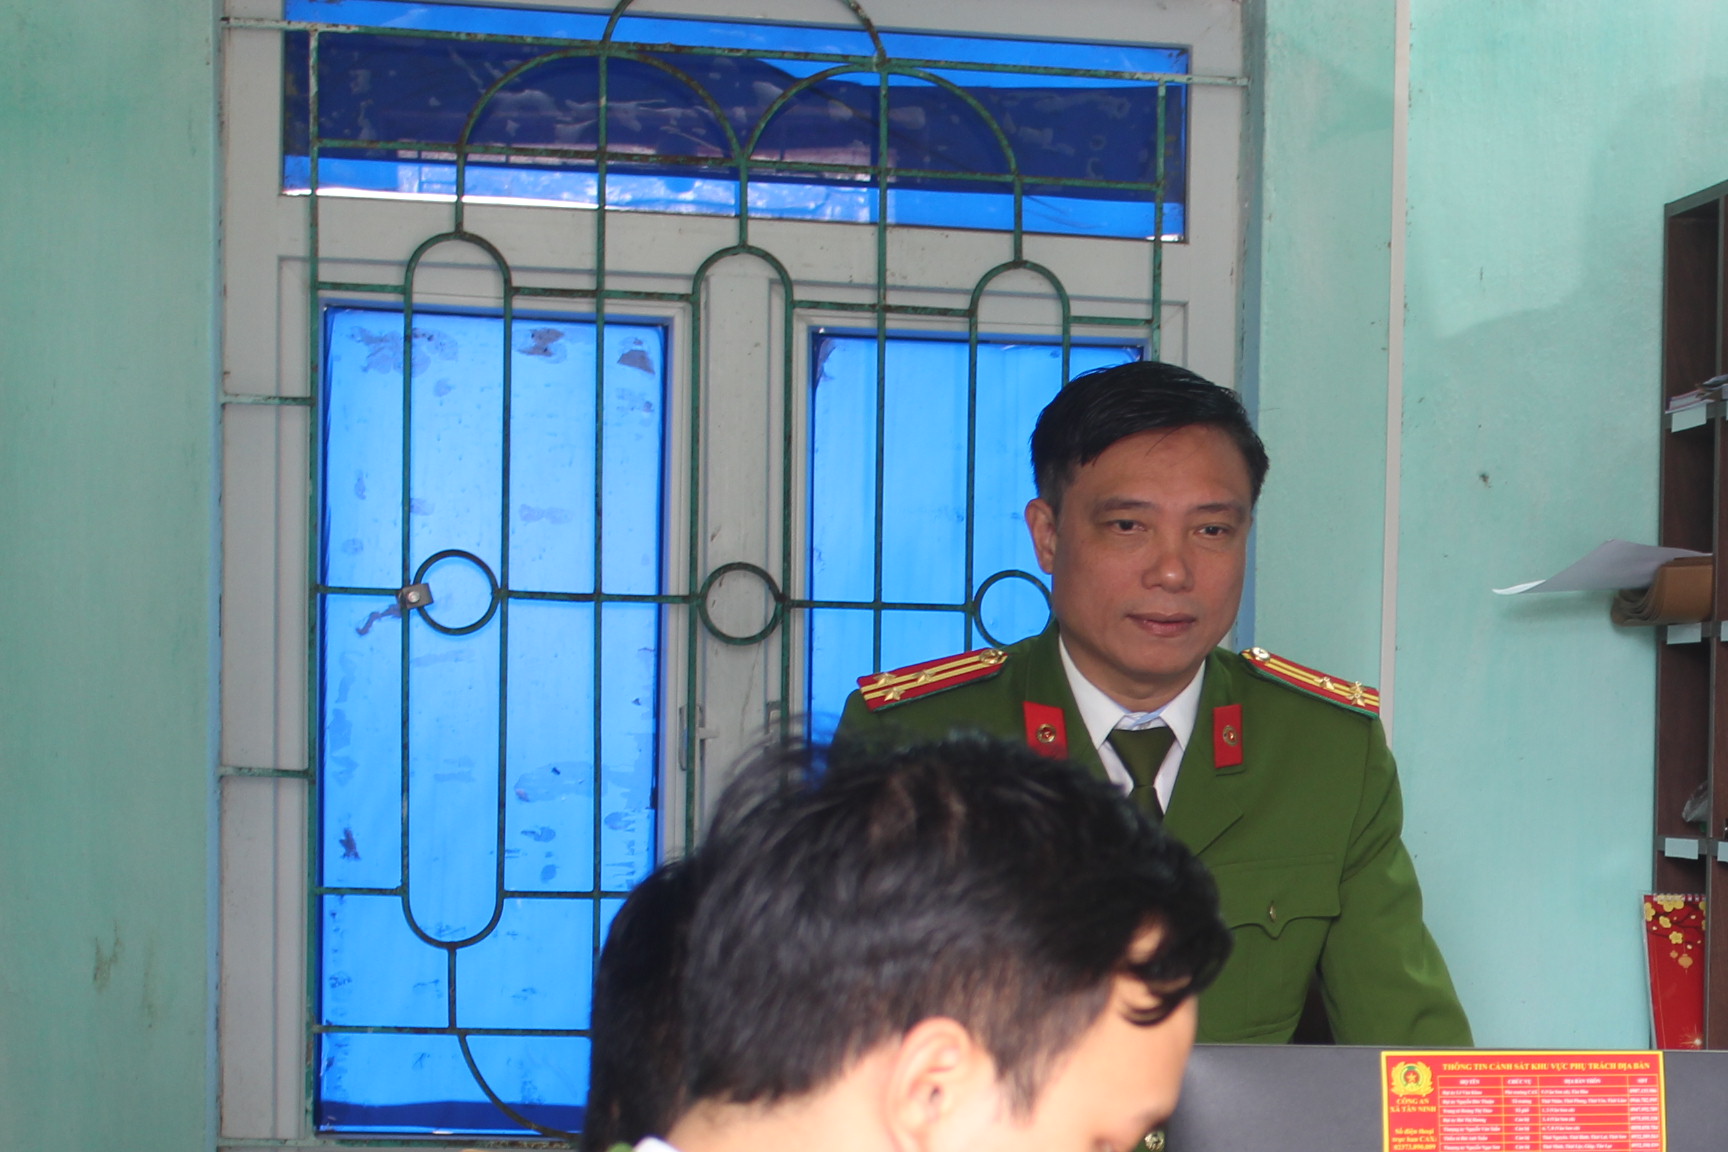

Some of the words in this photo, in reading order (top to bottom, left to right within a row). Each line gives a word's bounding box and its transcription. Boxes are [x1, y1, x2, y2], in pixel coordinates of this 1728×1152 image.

[1442, 1061, 1473, 1071] THÔNG
[1474, 1062, 1488, 1071] TIN
[1489, 1061, 1513, 1071] CẢNH
[1514, 1061, 1530, 1071] SÁT
[1531, 1062, 1549, 1071] KHU
[1550, 1062, 1568, 1072] VỰC
[1570, 1062, 1587, 1071] PHỤ
[1588, 1060, 1616, 1070] TRÁCH
[1618, 1062, 1632, 1071] ĐỊA
[1633, 1060, 1651, 1070] BÀN
